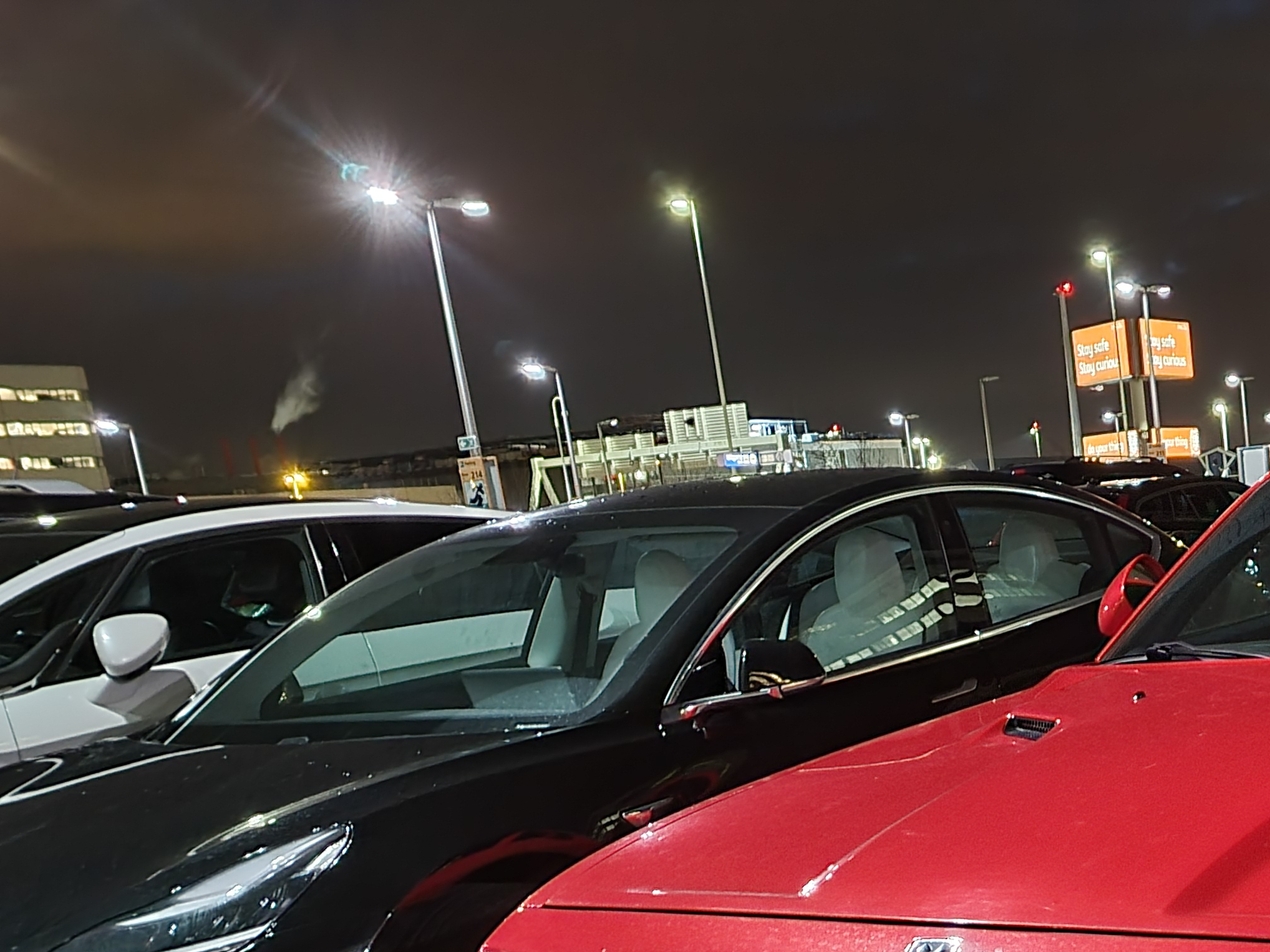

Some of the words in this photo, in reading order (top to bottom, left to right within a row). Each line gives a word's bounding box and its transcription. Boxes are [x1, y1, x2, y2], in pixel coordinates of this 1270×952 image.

[1077, 343, 1093, 358] Stay
[1094, 338, 1109, 353] safe
[1161, 334, 1176, 348] safe
[1079, 362, 1095, 376] Stay
[1096, 356, 1119, 371] curiou
[1163, 352, 1186, 366] curious
